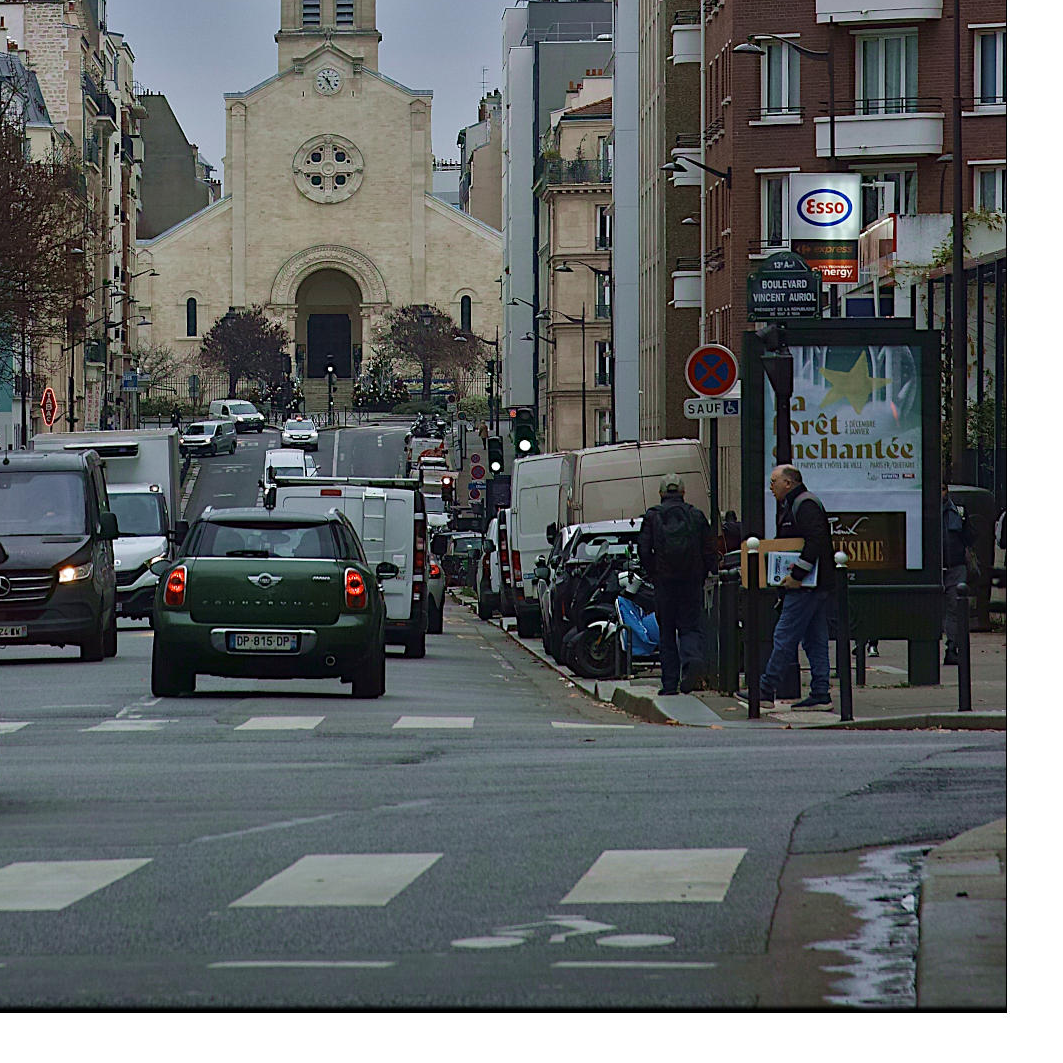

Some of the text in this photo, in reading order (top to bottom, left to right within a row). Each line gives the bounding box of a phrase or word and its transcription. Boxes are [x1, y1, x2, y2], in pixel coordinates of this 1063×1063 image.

[806, 199, 844, 214] Esso
[762, 280, 807, 289] BOULEVARD
[753, 292, 816, 302] VINCENT AURIOL
[688, 404, 720, 414] SAUF
[773, 413, 841, 435] orêt
[772, 437, 914, 459] nchantée
